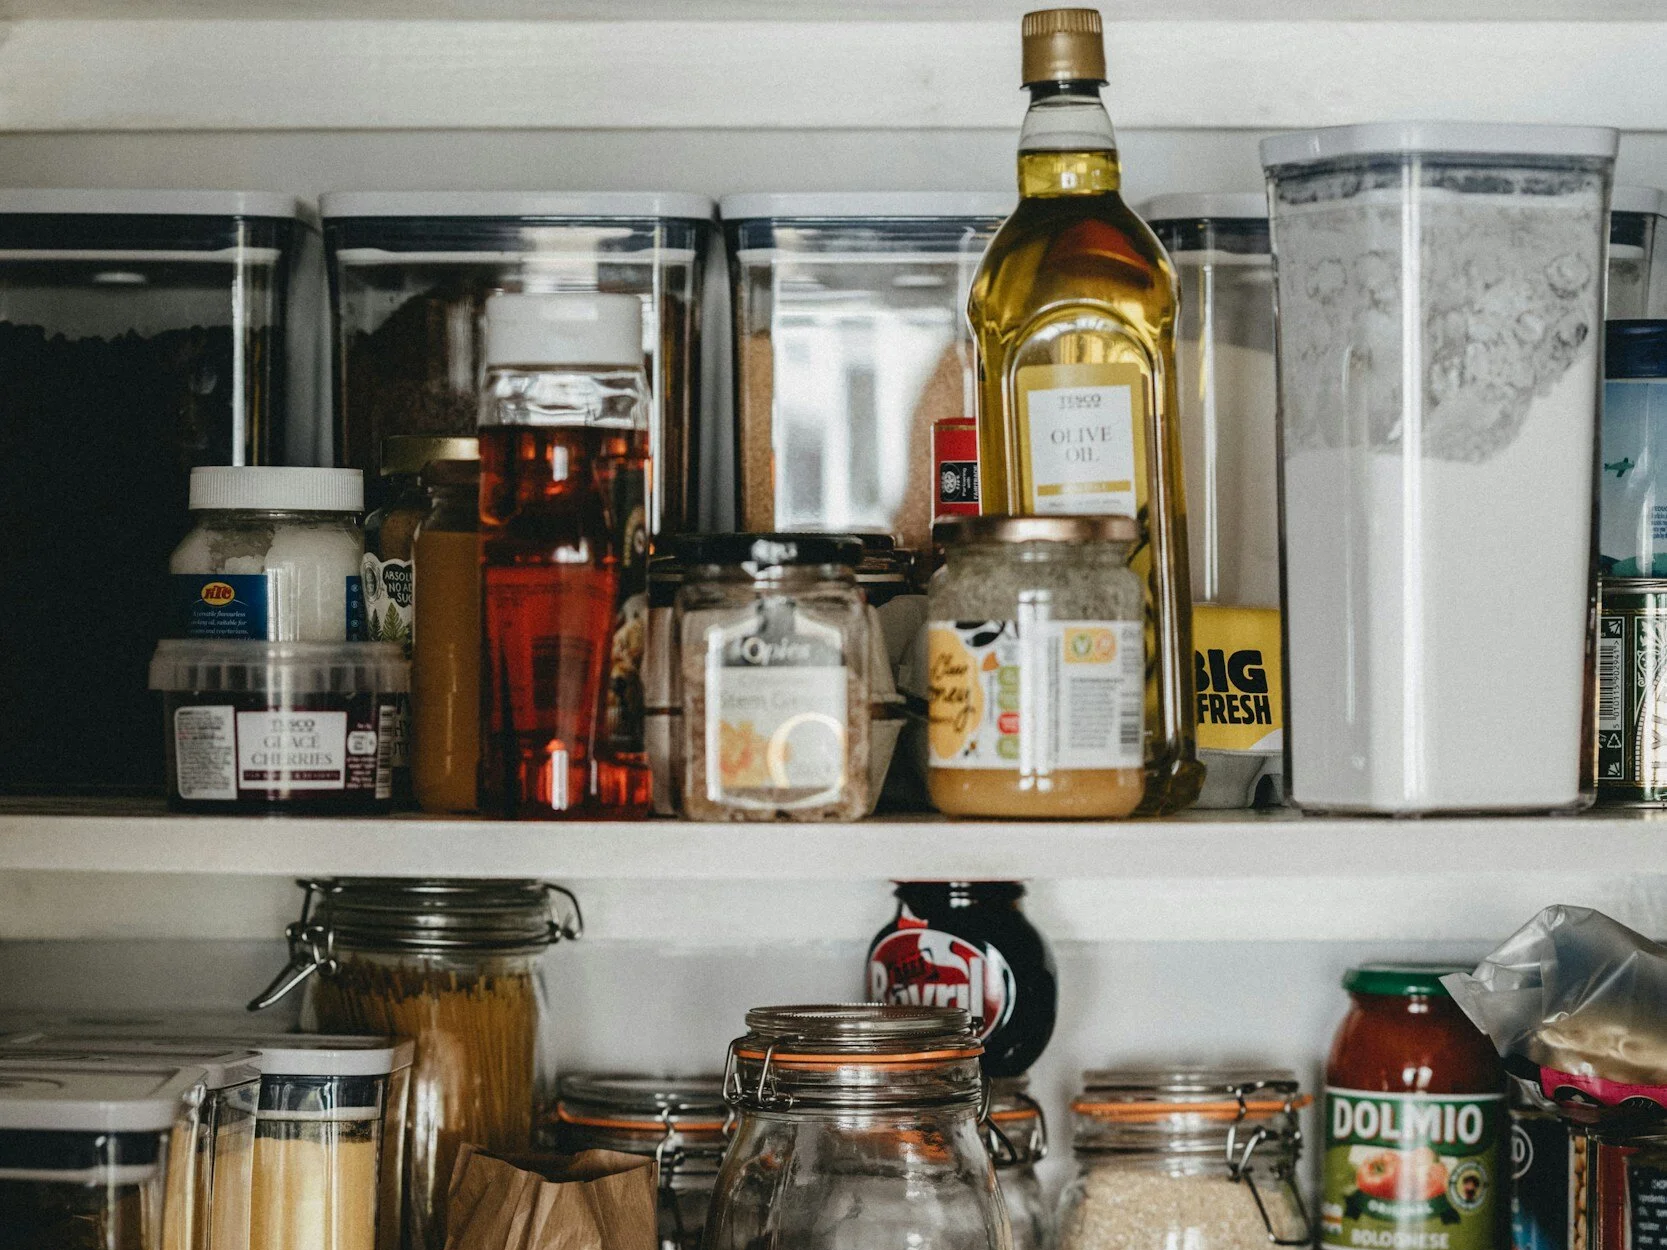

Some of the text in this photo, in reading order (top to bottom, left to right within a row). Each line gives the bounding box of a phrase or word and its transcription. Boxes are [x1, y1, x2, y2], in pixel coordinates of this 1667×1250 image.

[1050, 426, 1113, 444] OLIVE
[1065, 447, 1100, 462] OIL
[204, 585, 232, 600] KTC
[388, 583, 402, 593] NO
[1195, 649, 1268, 694] BIG
[1197, 694, 1272, 725] FRESH
[251, 752, 333, 766] CHERRIES
[1333, 1098, 1484, 1145] DOLMIO
[1351, 1228, 1449, 1250] BOLOGNESE
